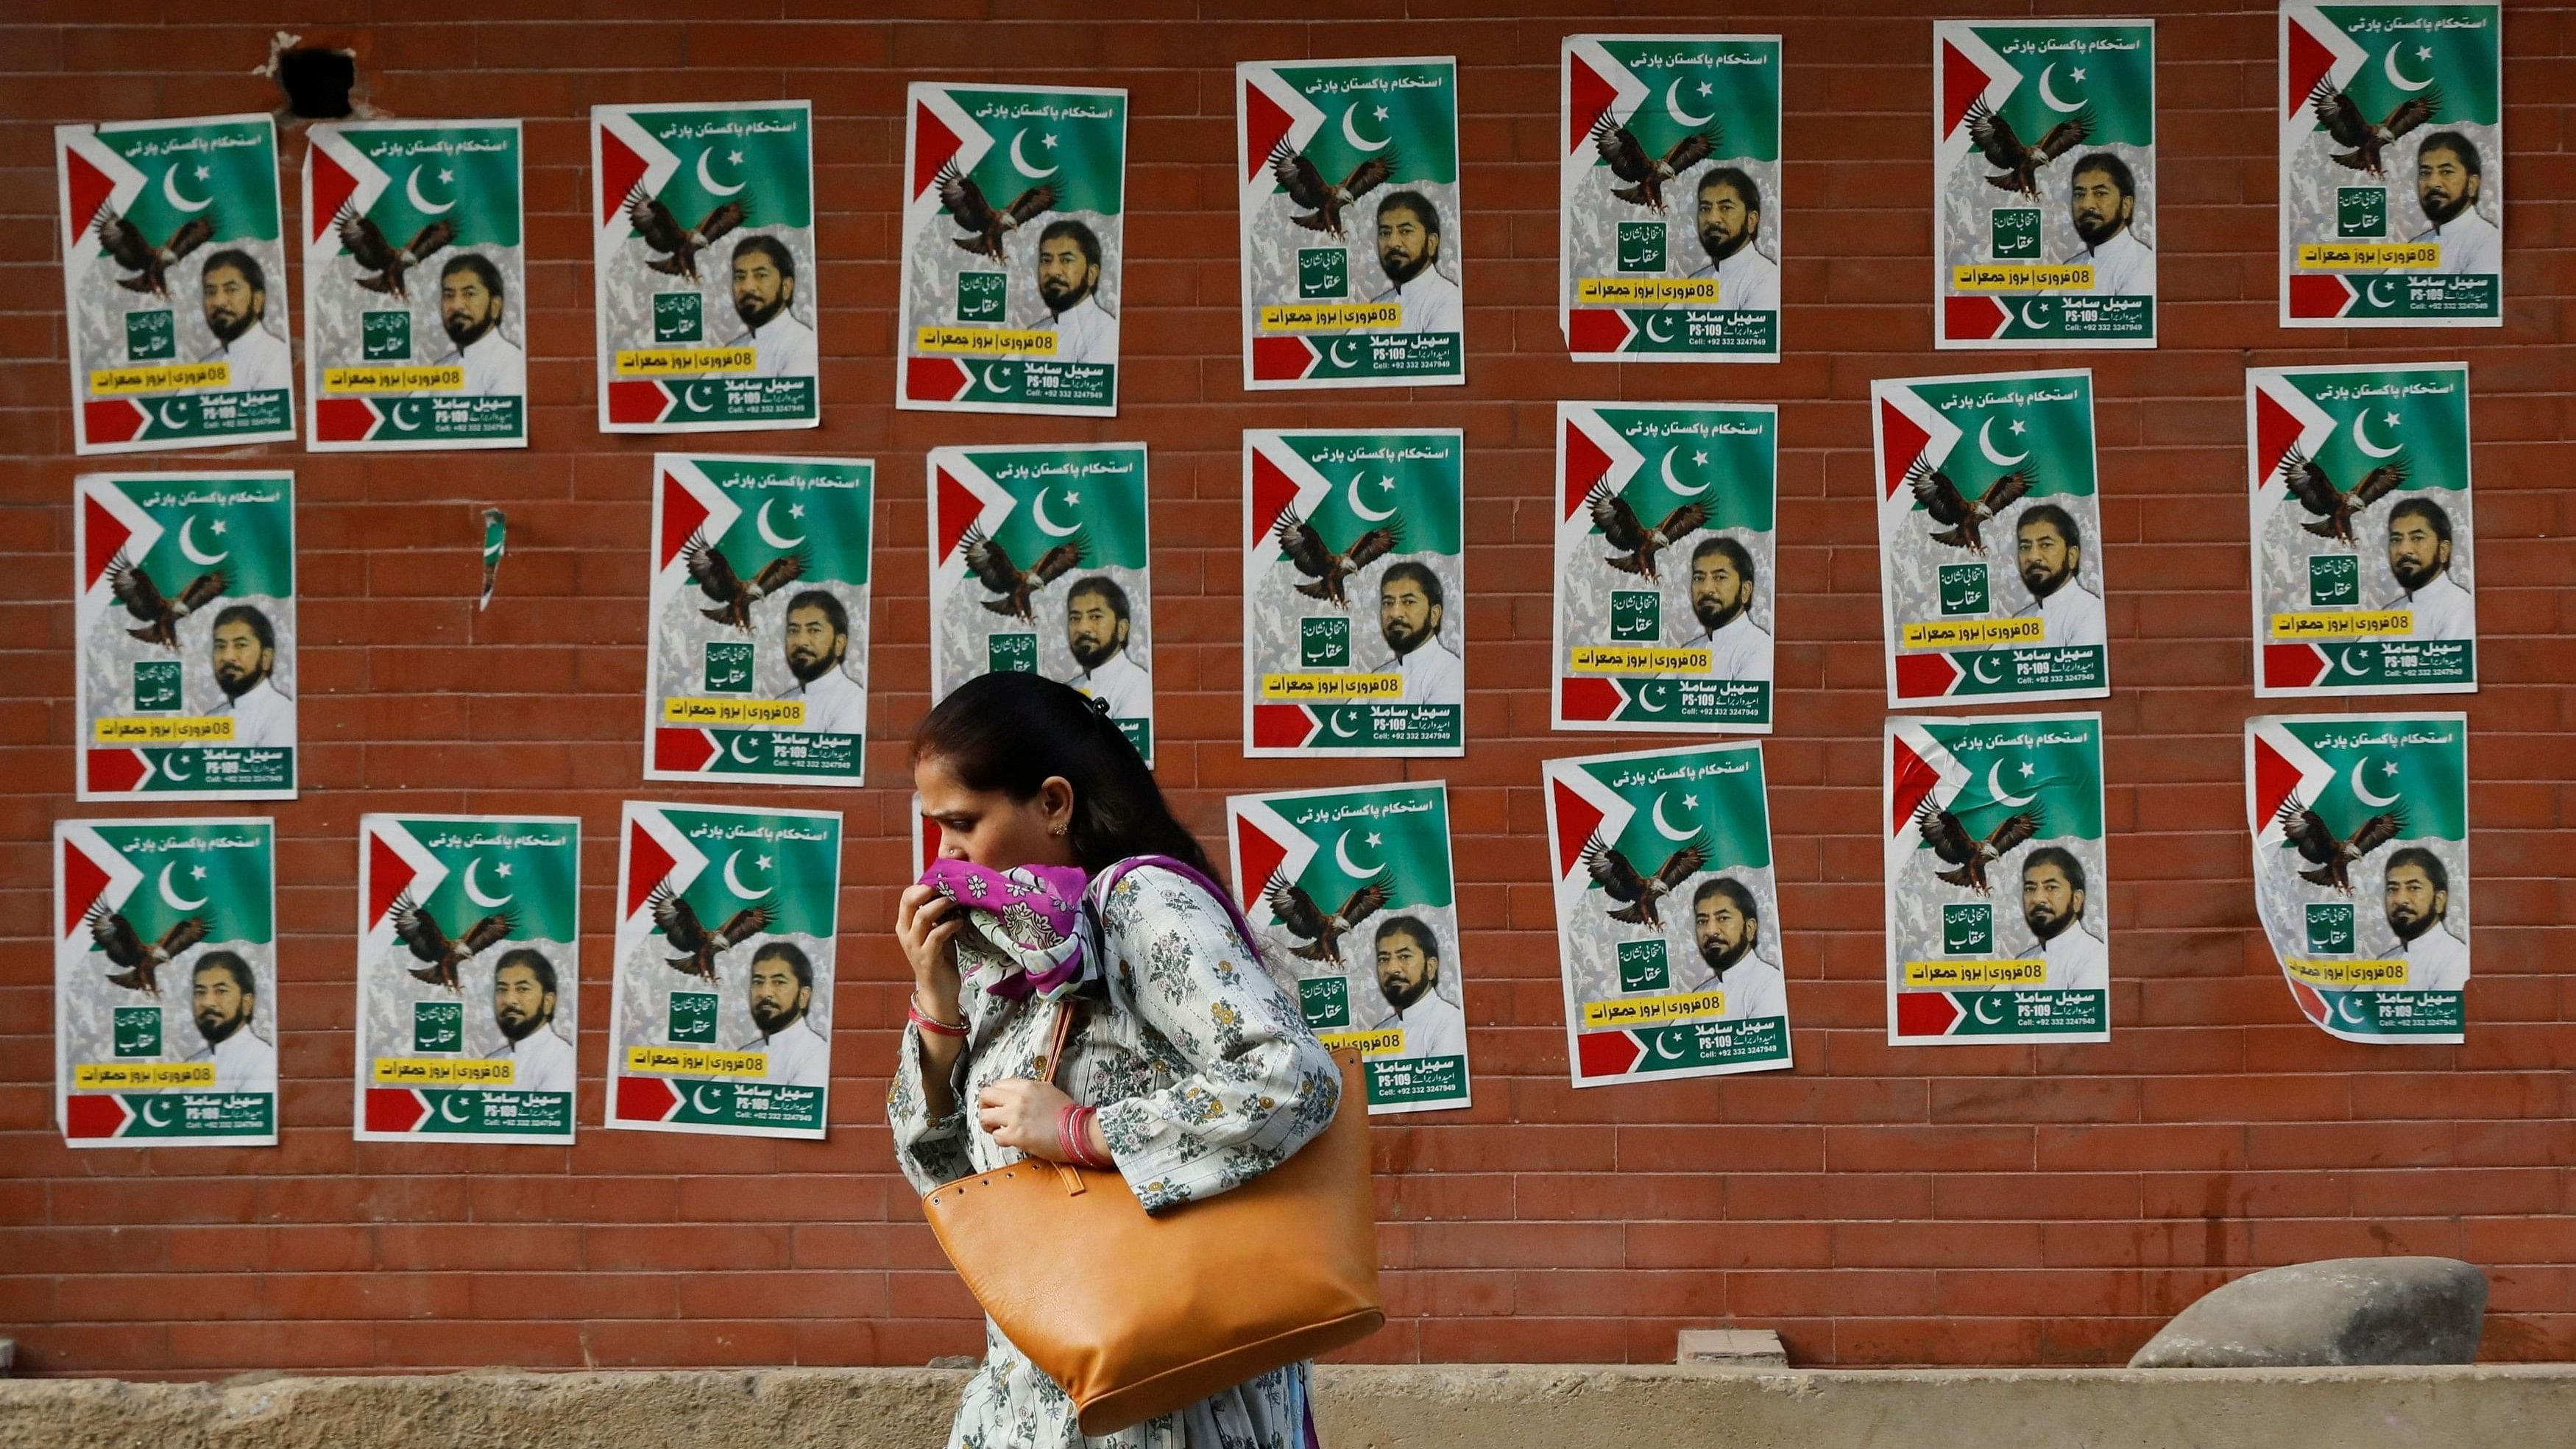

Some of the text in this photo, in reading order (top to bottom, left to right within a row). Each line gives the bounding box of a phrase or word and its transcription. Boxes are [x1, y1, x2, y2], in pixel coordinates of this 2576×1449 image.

[2003, 38, 2140, 55] استحکام پاکستان پارٹی
[1630, 52, 1767, 69] استحکام پاکستان پارٹی
[1306, 76, 1442, 94] استحکام پاکستان پارٹی
[976, 102, 1112, 121] استحکام پاکستان پارٹی
[696, 122, 743, 138] پاکستان
[406, 140, 453, 156] پاکستان
[1998, 235, 2034, 254] عقاب
[1624, 248, 1659, 267] عقاب
[1305, 274, 1340, 294] عقاب
[963, 298, 999, 317] عقاب
[1690, 324, 1722, 336] PS-109
[1941, 389, 2078, 410] استحکام پاکستان پارٹی
[1626, 420, 1763, 439] استحکام پاکستان پارٹی
[1312, 447, 1448, 464] استحکام پاکستان پارٹی
[1032, 463, 1079, 478] پاکستان
[758, 474, 806, 492] پاکستان
[179, 491, 227, 507] پاکستان
[1947, 590, 1982, 610] عقاب
[1617, 617, 1652, 637] عقاب
[1307, 643, 1342, 662] عقاب
[1682, 693, 1714, 706] PS-109
[1374, 718, 1406, 731] PS-109
[1986, 734, 2034, 749] پاکستان
[2037, 732, 2087, 748] استحکام
[2350, 733, 2398, 749] پاکستان
[1613, 761, 1749, 787] استحکام پاکستان پارٹی
[1297, 800, 1432, 824] استحکام پاکستان پارٹی
[464, 833, 512, 850] پاکستان
[726, 825, 774, 843] پاکستان
[1950, 930, 1986, 950] عقاب
[1626, 967, 1661, 987] عقاب
[1306, 1004, 1342, 1024] عقاب
[1699, 1035, 1732, 1049] PS-109
